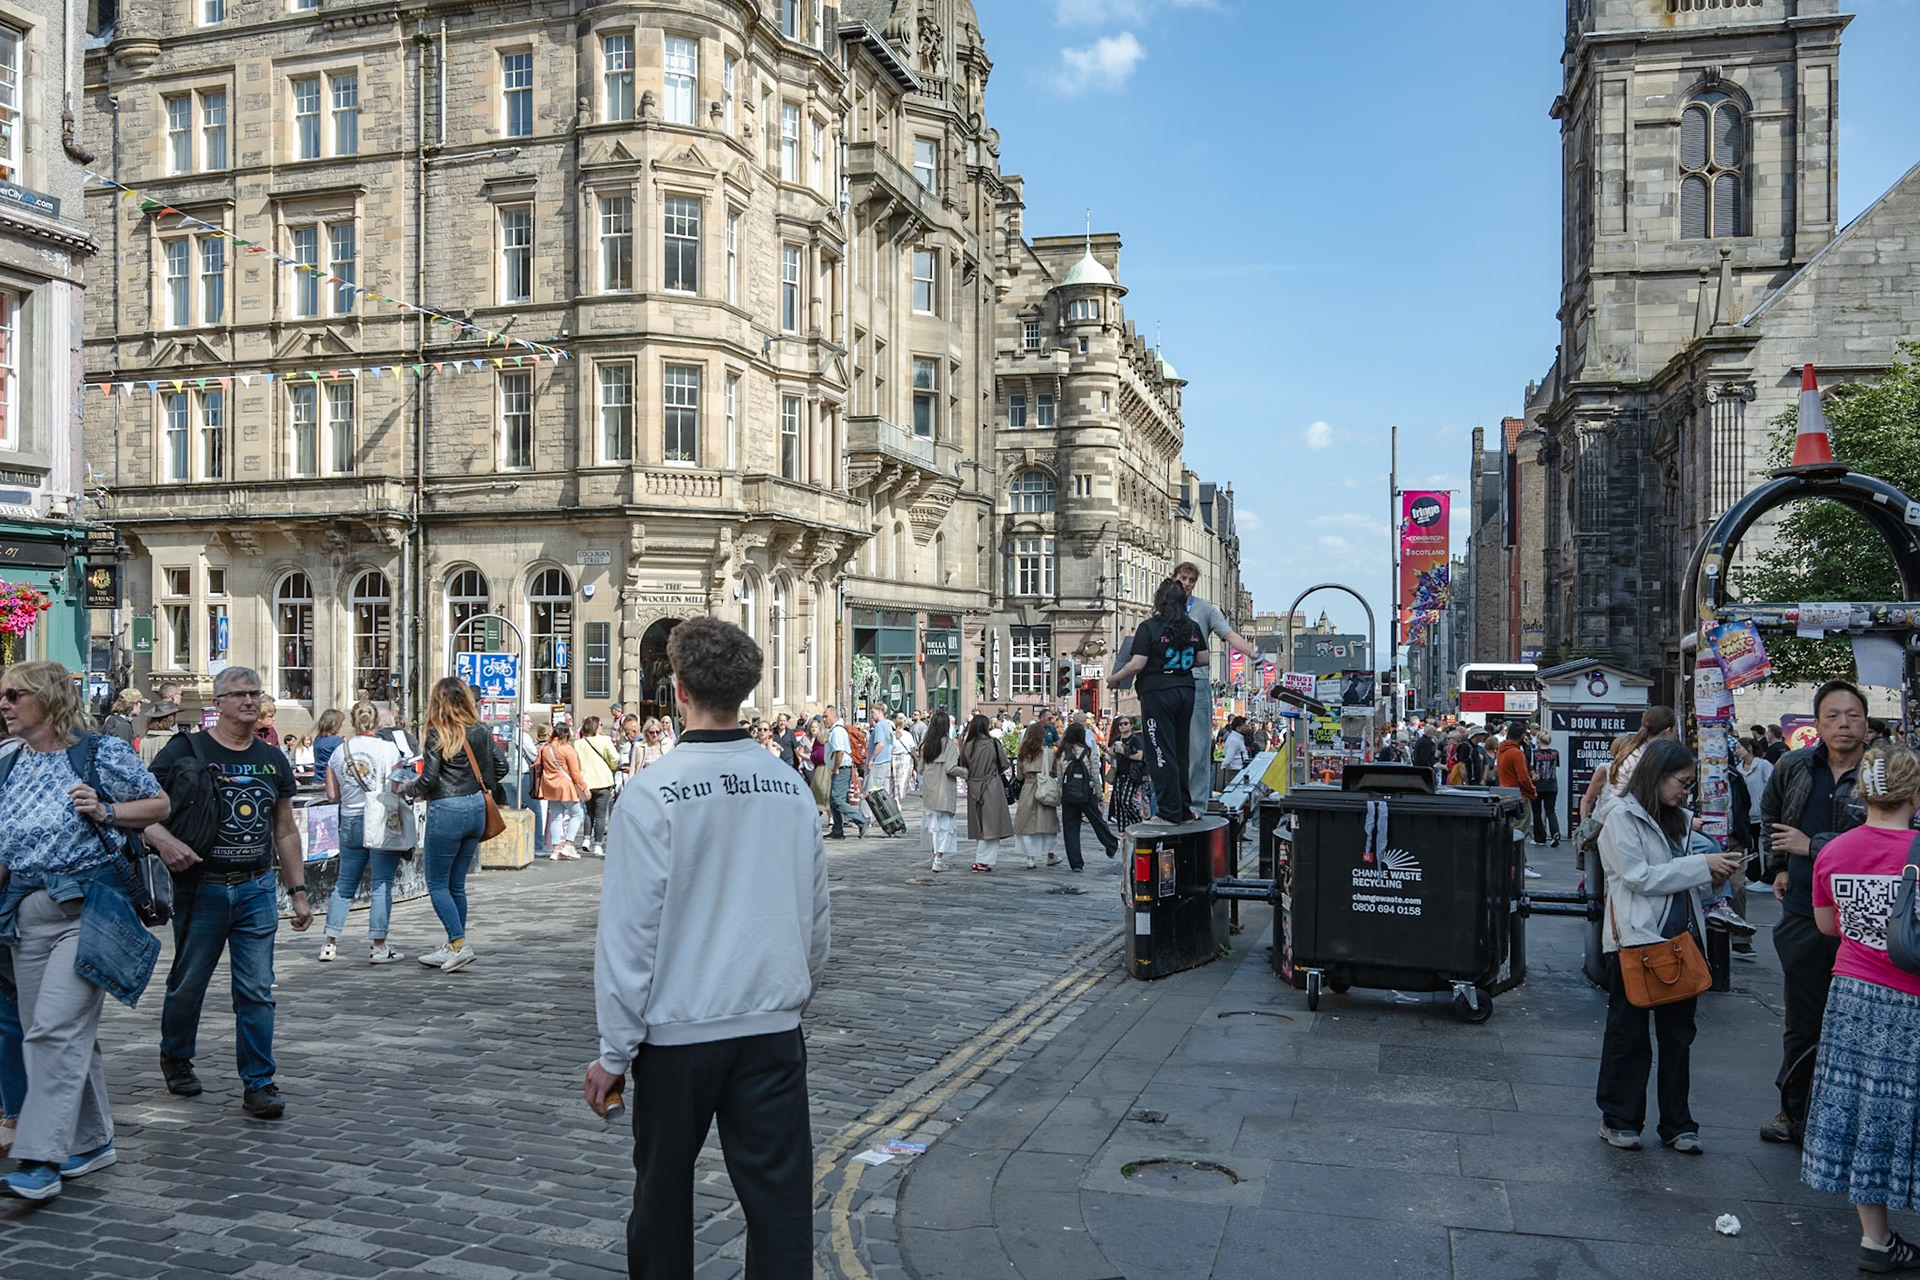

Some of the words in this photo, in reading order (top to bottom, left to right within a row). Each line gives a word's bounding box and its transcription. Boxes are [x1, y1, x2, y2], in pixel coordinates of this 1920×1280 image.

[15, 474, 39, 485] MILE
[1411, 504, 1440, 519] fringe
[664, 583, 682, 591] THE
[641, 594, 682, 603] WOOLLEN
[685, 595, 705, 604] MILL
[926, 641, 947, 649] BELLA
[1163, 646, 1195, 671] 26
[1286, 674, 1313, 682] TRUST
[1510, 702, 1534, 710] THE
[1571, 717, 1597, 729] BOOK
[1601, 718, 1626, 730] HERE
[1583, 740, 1600, 750] CITY
[1600, 741, 1610, 750] OF
[1577, 749, 1614, 759] EDINBURG
[659, 781, 713, 804] New
[720, 773, 800, 796] Balance
[1390, 870, 1422, 881] WASTE
[1352, 877, 1402, 889] RECYCLING
[1352, 893, 1422, 905] changewaste.com
[1352, 902, 1376, 912] 0800
[1377, 904, 1395, 913] 694
[1397, 905, 1421, 916] 0158
